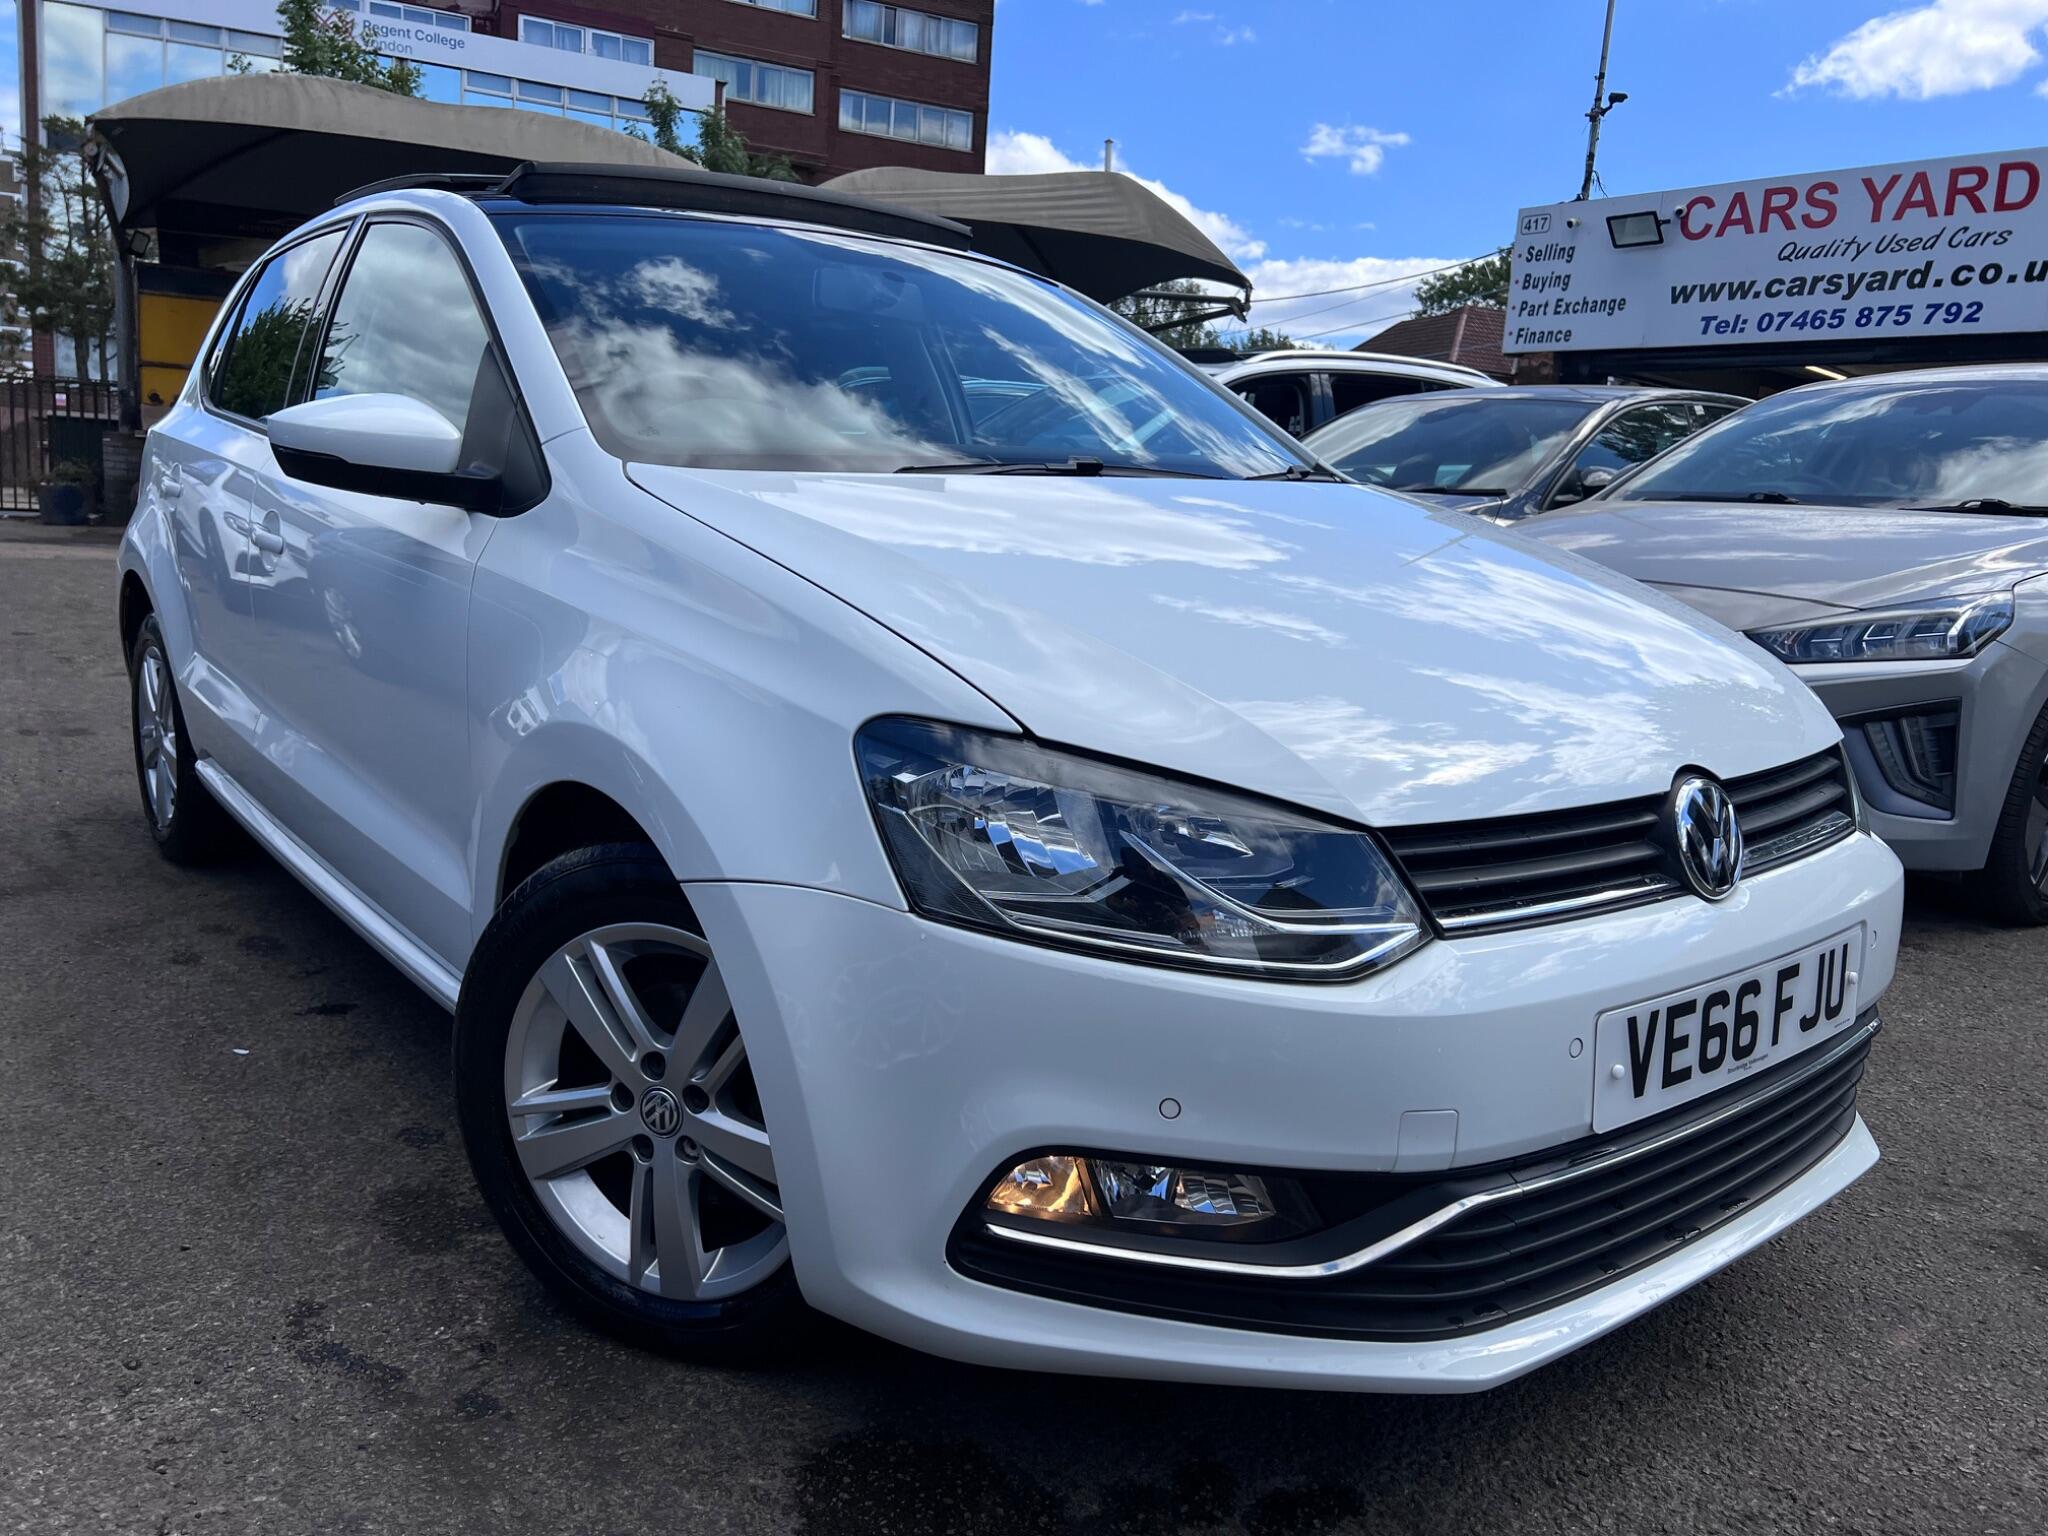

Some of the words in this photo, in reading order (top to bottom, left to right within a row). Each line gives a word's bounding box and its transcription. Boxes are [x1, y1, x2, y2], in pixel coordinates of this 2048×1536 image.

[363, 20, 410, 39] Regent
[415, 29, 465, 49] College
[1680, 181, 1839, 241] CARS
[1861, 161, 2040, 223] YARD
[1523, 217, 1548, 232] 417
[1525, 243, 1575, 263] Selling
[1777, 236, 1871, 262] Quality
[1874, 227, 1947, 255] Used
[1948, 226, 2014, 249] Cars
[1522, 271, 1571, 293] Buying
[1518, 299, 1549, 318] Part
[1553, 296, 1627, 316] Exchange
[1700, 315, 1748, 336] Tel:
[1756, 308, 1847, 333] 07465
[1854, 304, 1914, 328] 875
[1923, 301, 1984, 326] 792
[1515, 327, 1572, 345] Finance
[1626, 978, 1762, 1100] VE66
[1771, 942, 1849, 1048] FJU
